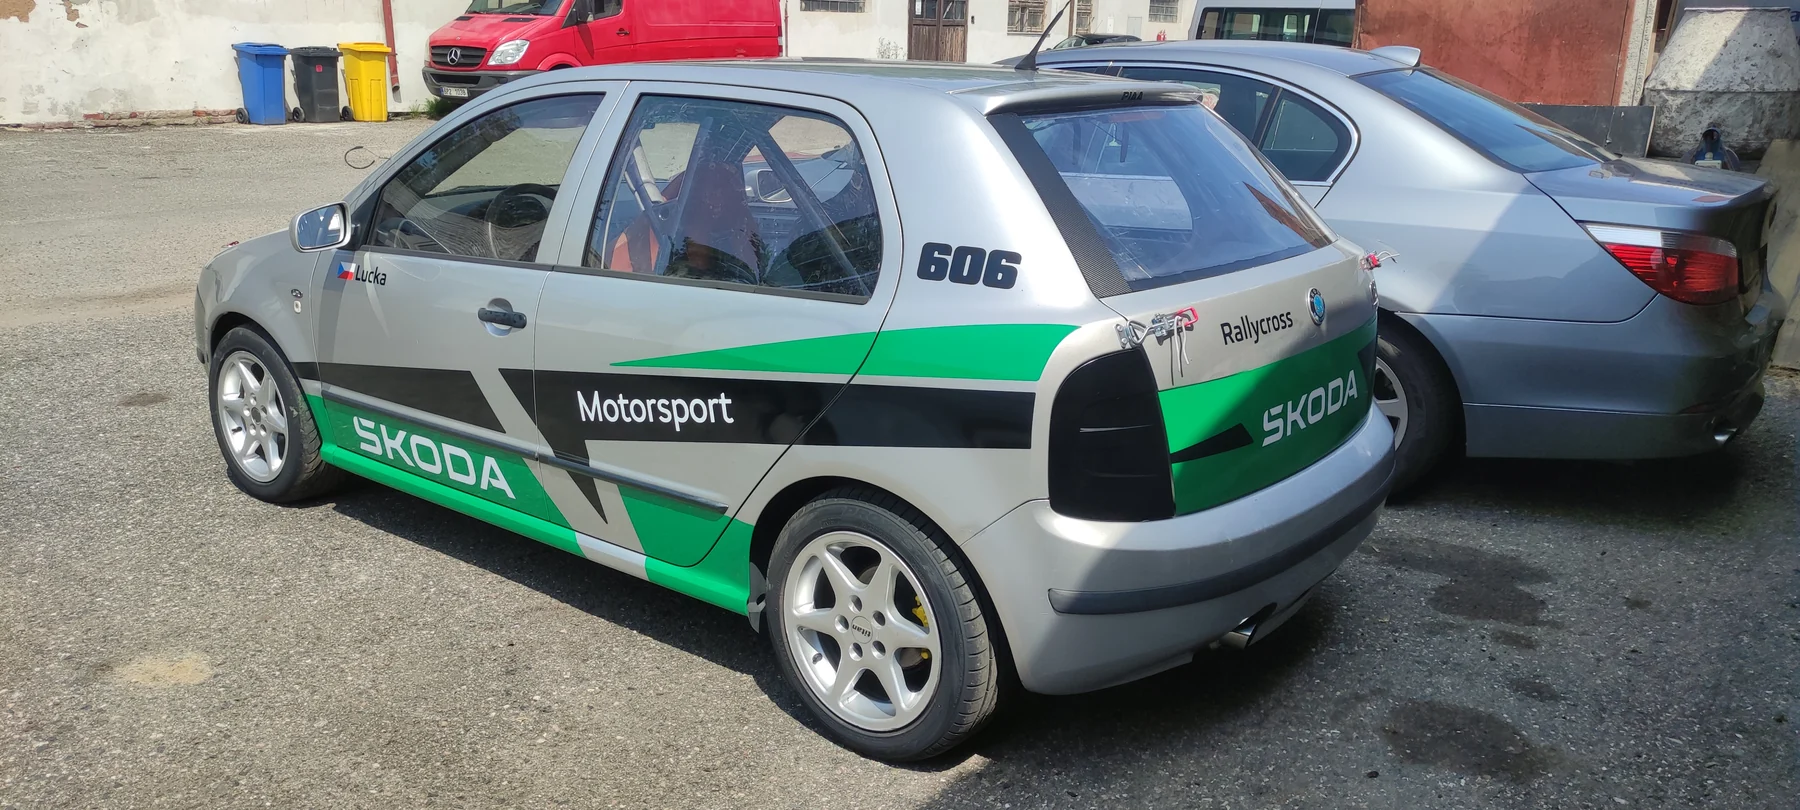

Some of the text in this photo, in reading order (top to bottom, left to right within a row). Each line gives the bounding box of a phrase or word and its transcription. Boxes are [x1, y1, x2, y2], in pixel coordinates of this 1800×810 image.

[1121, 91, 1143, 100] PIAA
[355, 265, 387, 286] Lucka
[917, 242, 1022, 290] 606
[1221, 311, 1294, 345] Rallycross
[577, 390, 734, 432] Motorsport
[852, 624, 871, 637] titan
